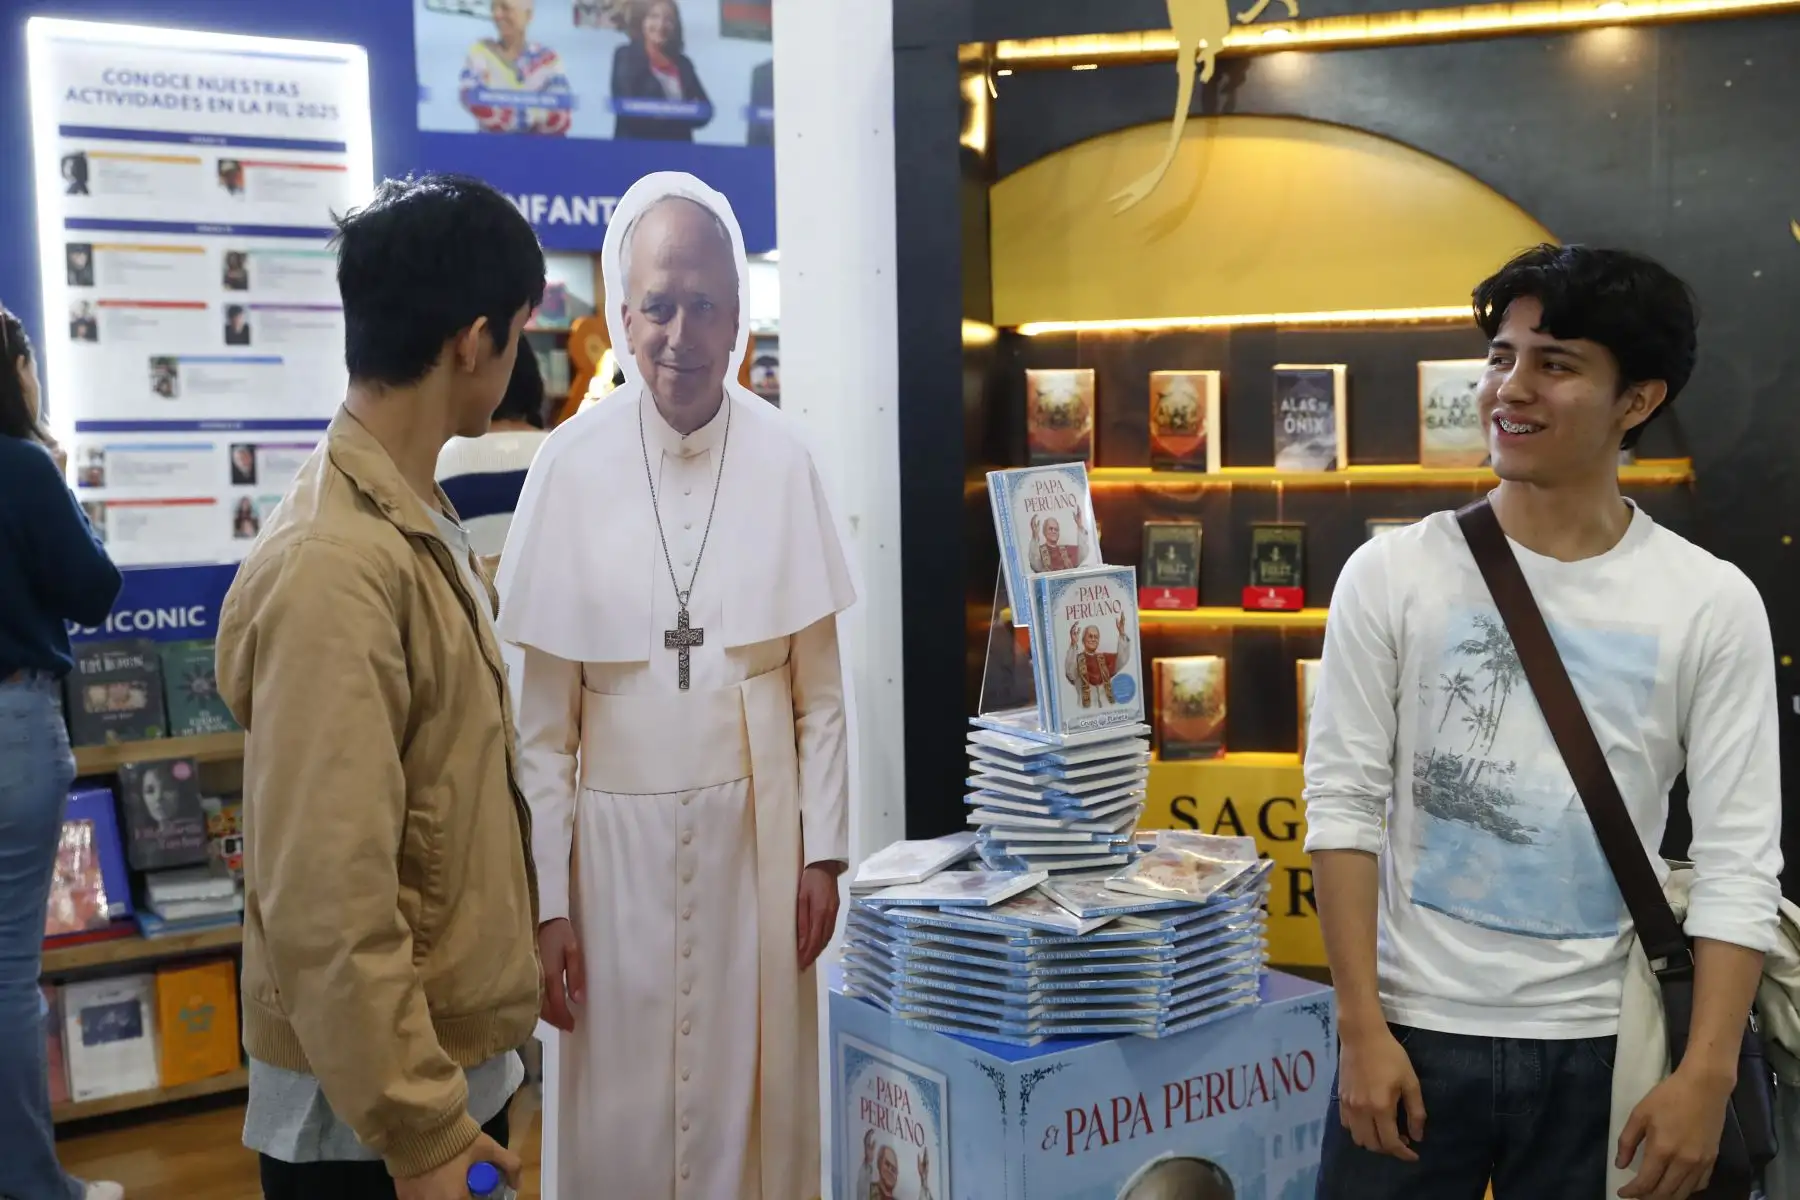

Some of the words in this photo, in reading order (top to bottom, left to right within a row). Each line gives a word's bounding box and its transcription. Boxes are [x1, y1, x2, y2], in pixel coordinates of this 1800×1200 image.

[102, 68, 191, 90] CONOCE
[197, 76, 300, 98] NUESTRAS
[65, 86, 201, 112] ACTIVIDADES
[208, 95, 234, 114] EN
[238, 97, 262, 115] LA
[266, 100, 290, 118] FIL
[504, 193, 618, 226] NFANT
[1281, 397, 1317, 411] ALAS
[1426, 413, 1479, 430] SANGR
[1034, 479, 1066, 496] PAPA
[1023, 493, 1078, 513] PERUANO
[1078, 584, 1111, 602] PAPA
[105, 606, 206, 633] ICONIC
[1064, 599, 1122, 621] PERUANO
[1169, 796, 1302, 841] SAG
[876, 1076, 911, 1116] PAPA
[1042, 1124, 1060, 1151] El
[1064, 1091, 1154, 1156] PAPA
[1162, 1049, 1316, 1130] PERUANO
[860, 1096, 925, 1148] PERUANO
